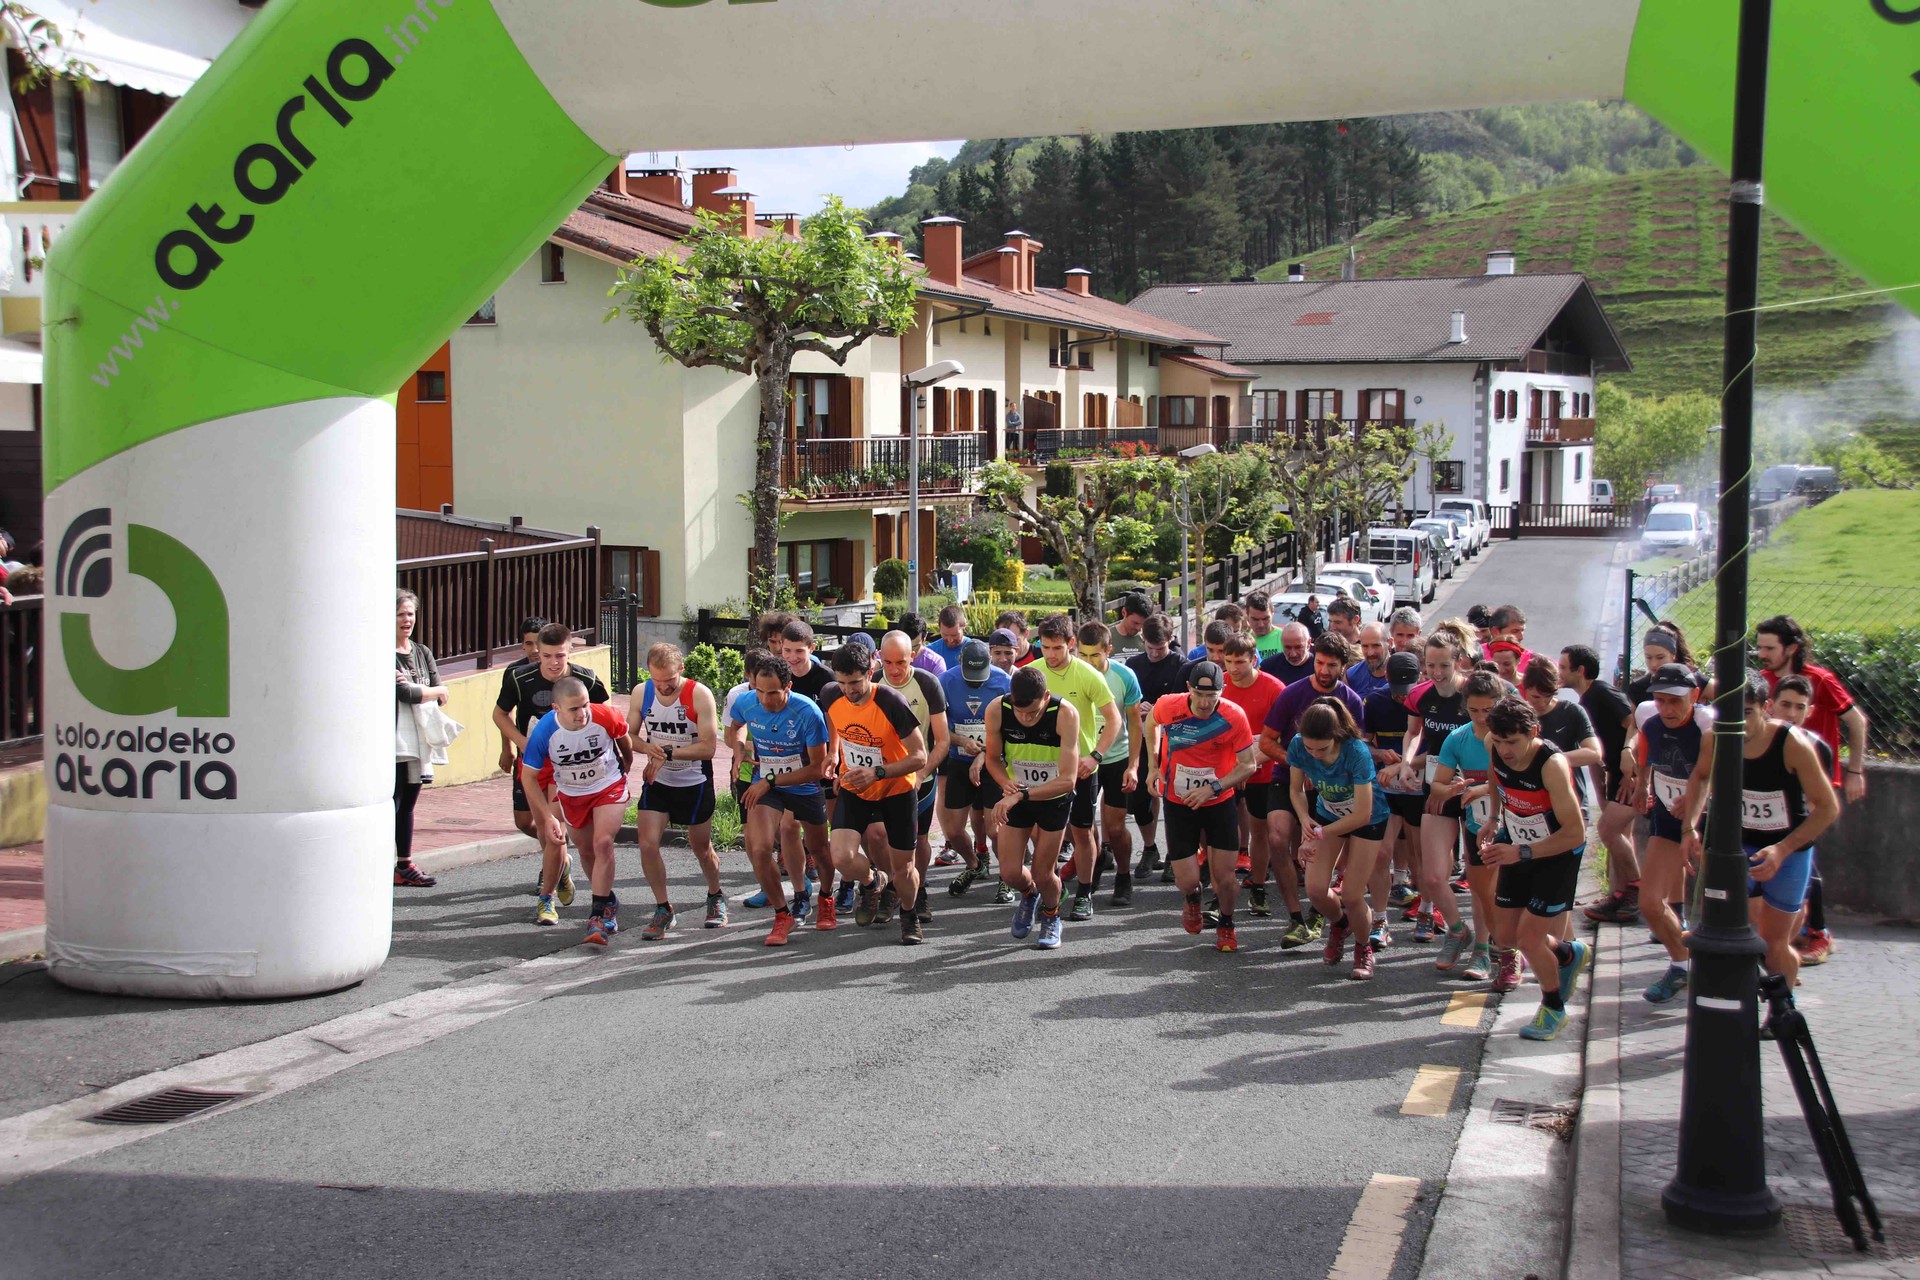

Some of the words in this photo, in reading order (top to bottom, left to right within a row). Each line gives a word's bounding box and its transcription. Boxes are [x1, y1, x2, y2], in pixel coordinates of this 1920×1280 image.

[648, 722, 688, 734] ZMT
[56, 722, 236, 754] tolosaldeko
[559, 747, 603, 763] ZMT
[850, 751, 873, 768] 129
[55, 753, 238, 800] ataria
[571, 769, 596, 781] 140
[1023, 769, 1049, 782] 109
[1742, 800, 1772, 818] 125
